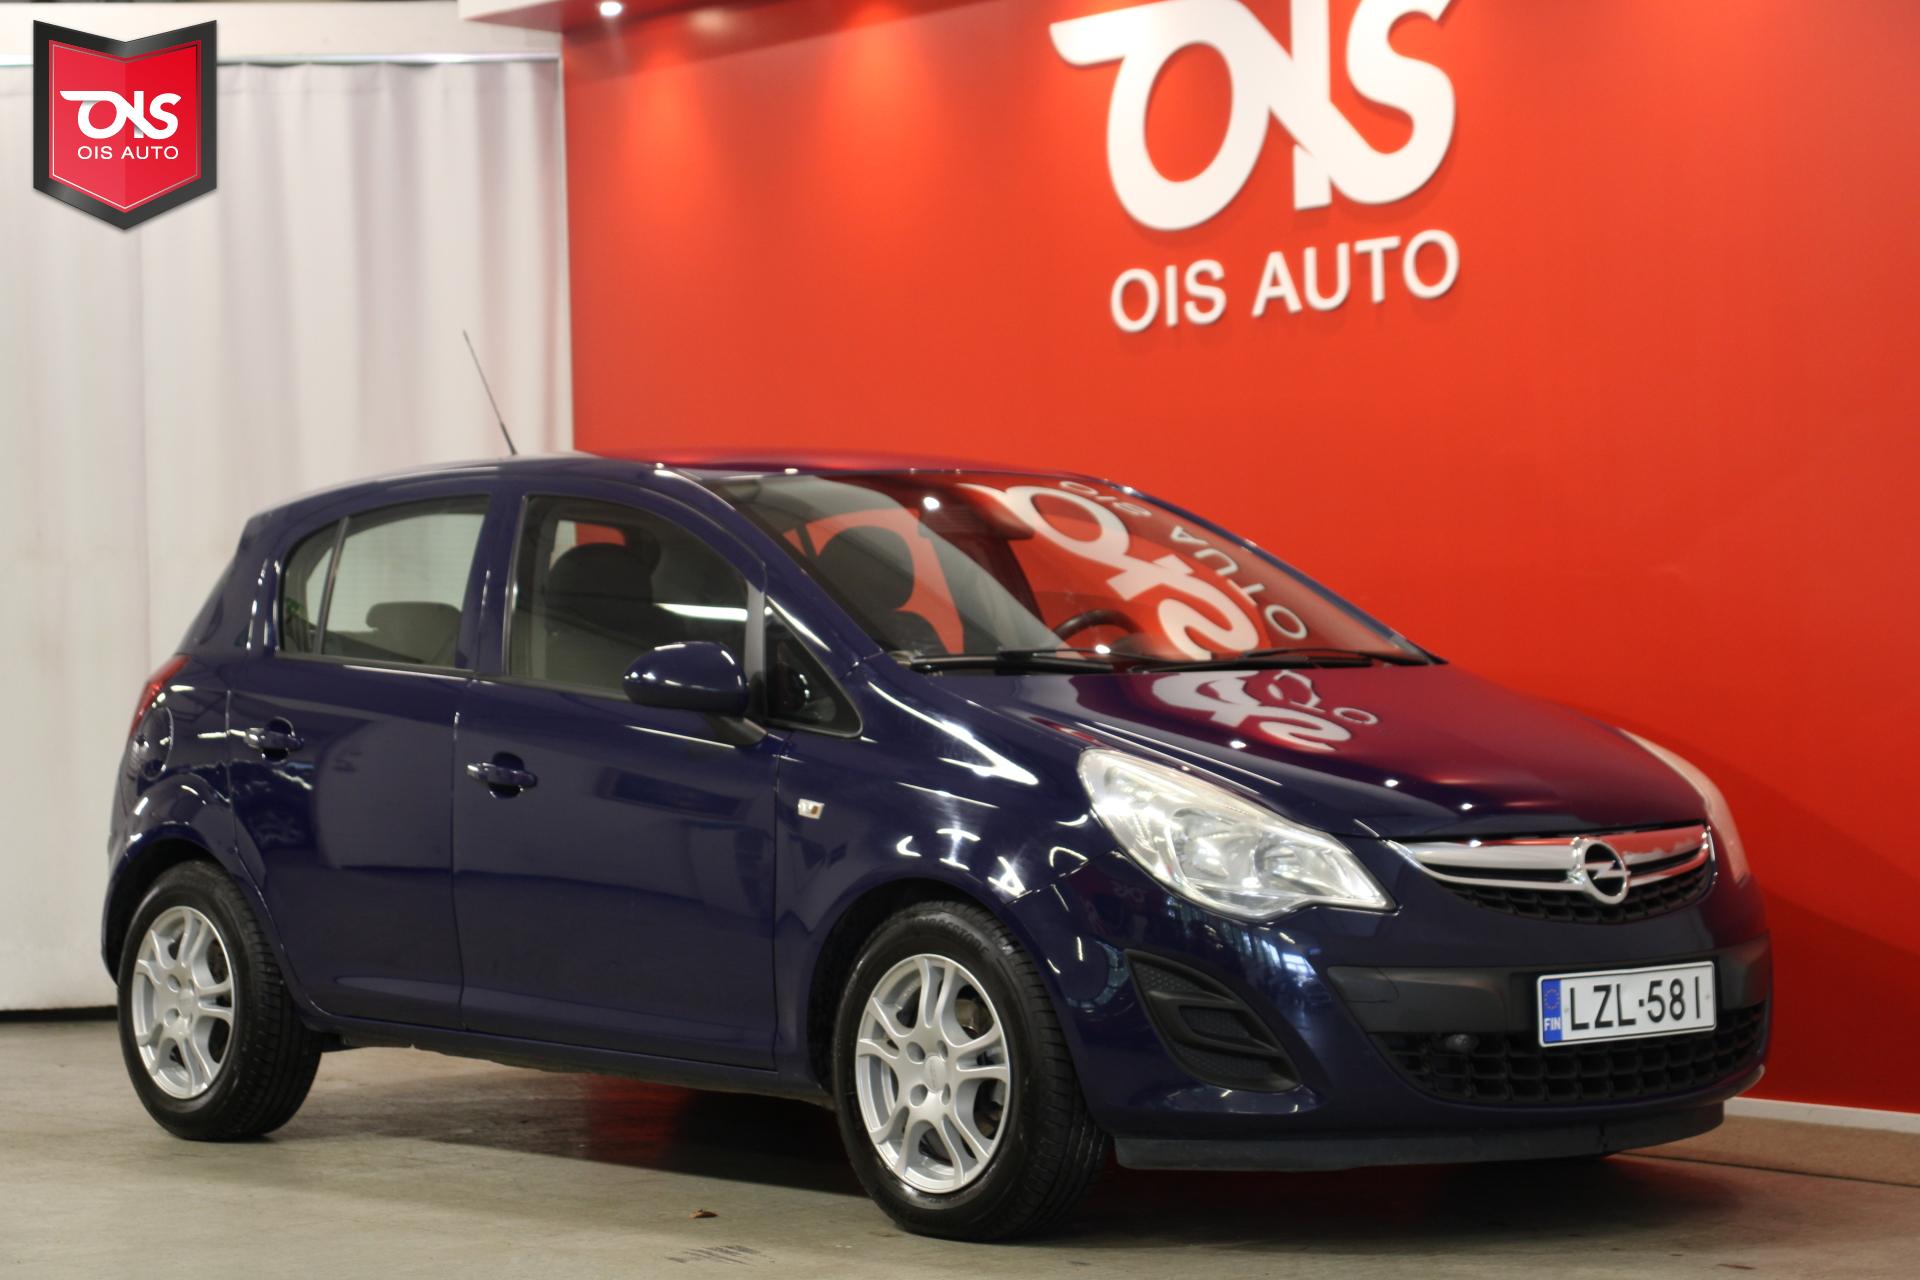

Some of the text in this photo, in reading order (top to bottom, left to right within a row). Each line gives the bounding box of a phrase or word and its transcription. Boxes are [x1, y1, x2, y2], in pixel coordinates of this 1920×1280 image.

[1048, 0, 1457, 231] OIS
[1110, 229, 1460, 333] OIS AUTO
[1543, 1016, 1562, 1032] FIN
